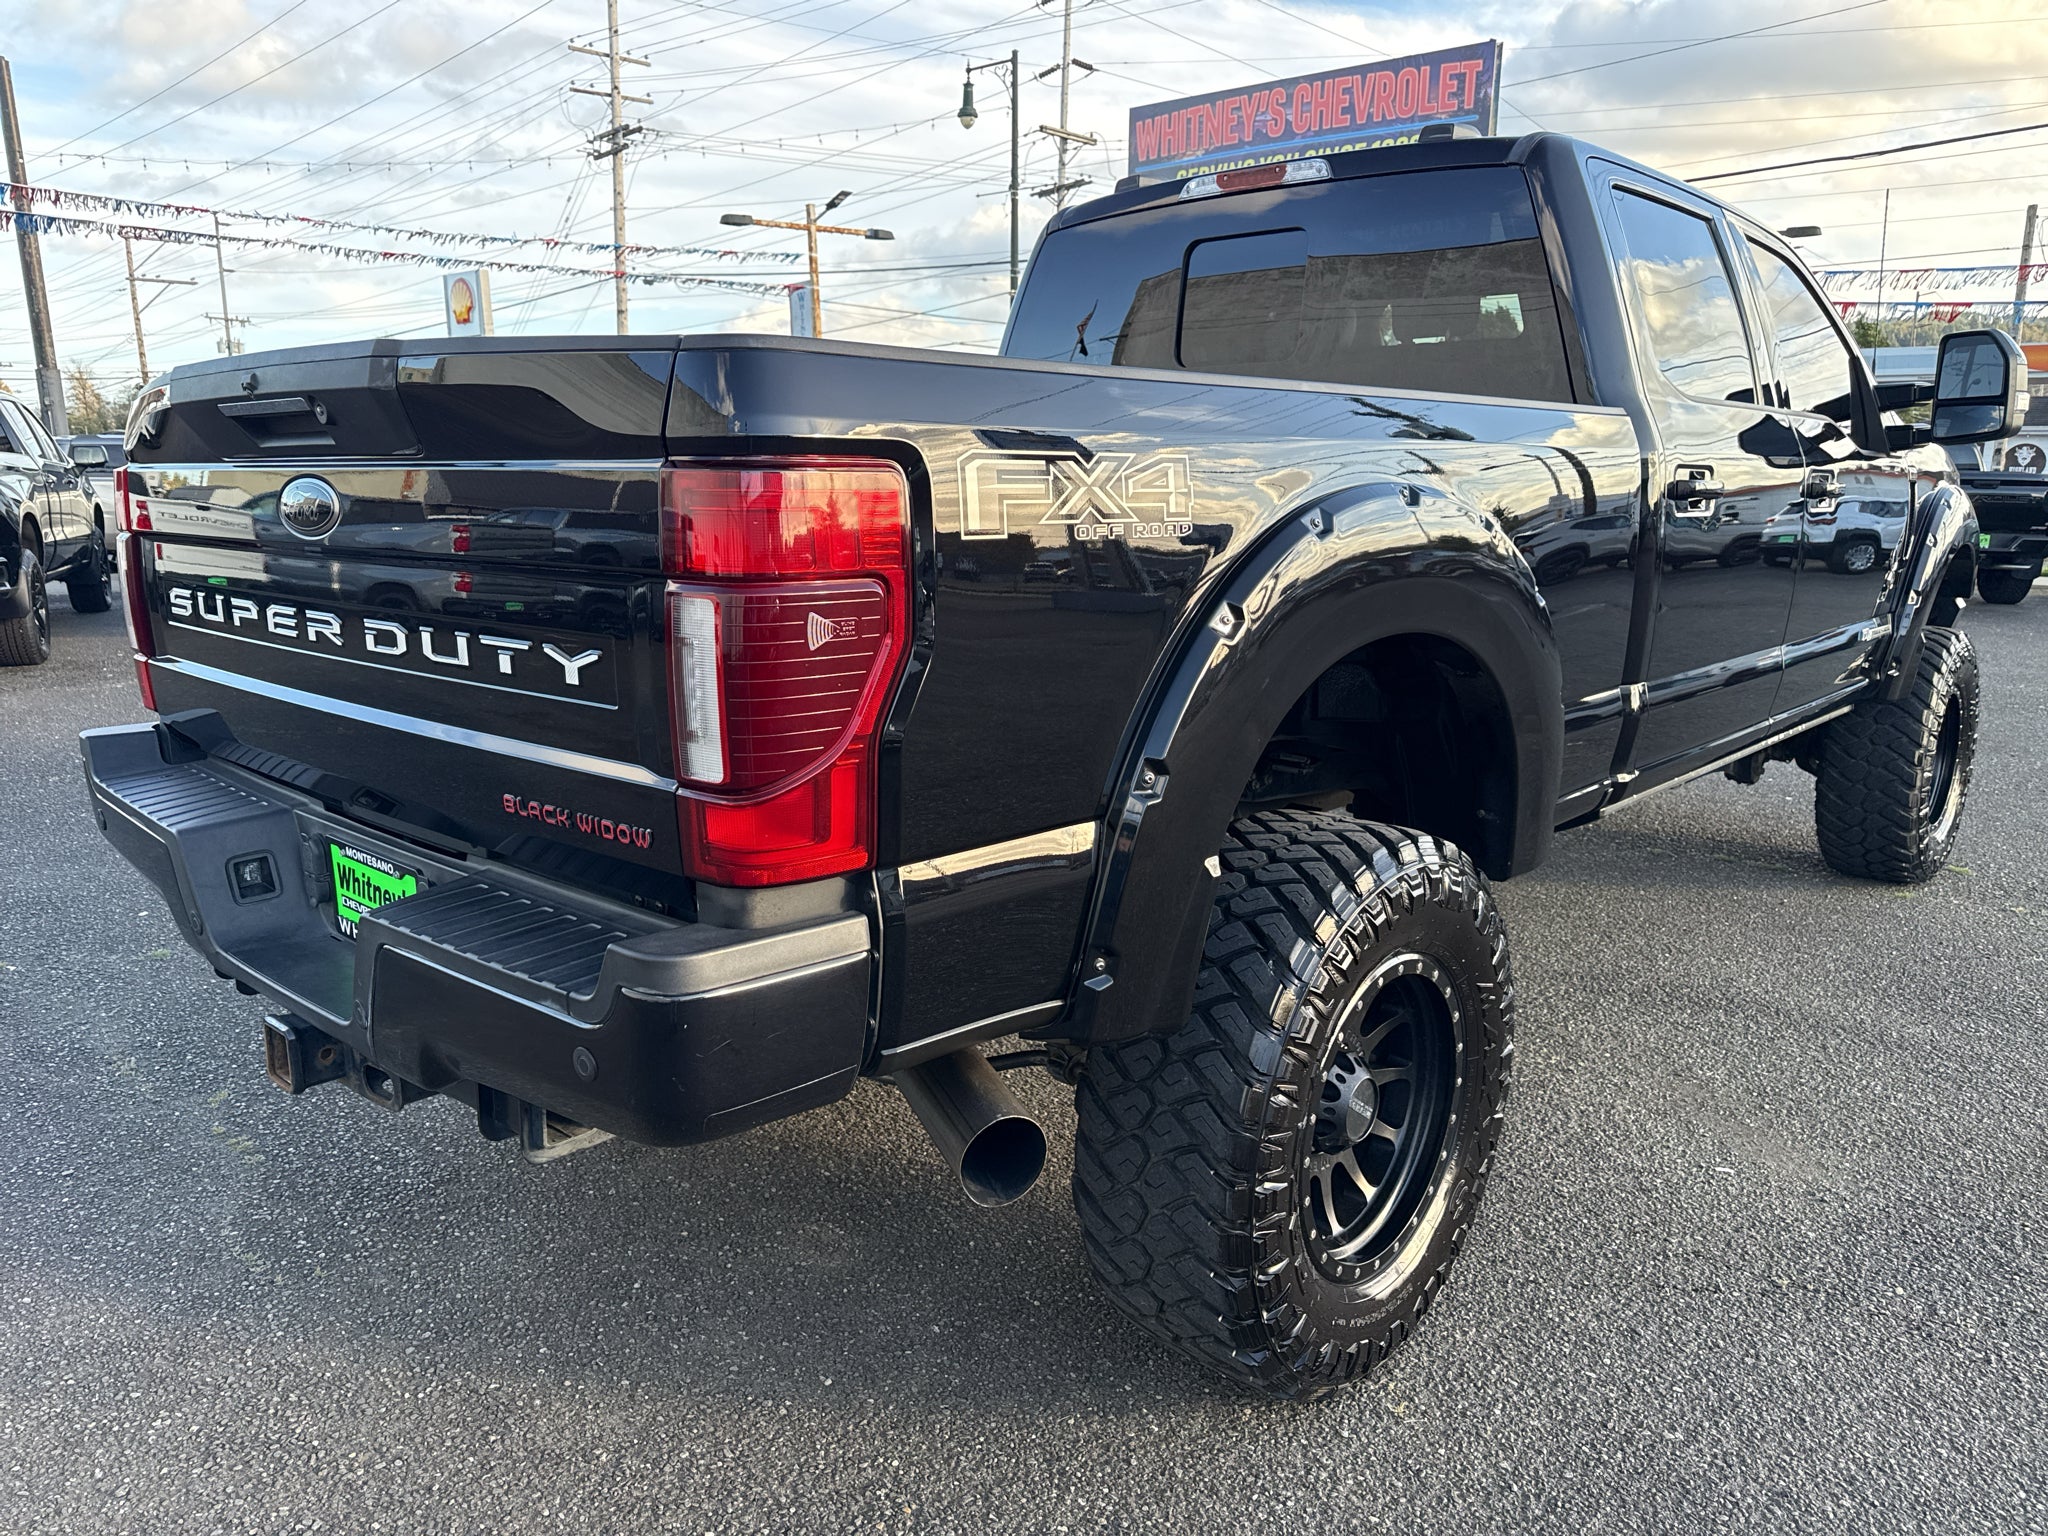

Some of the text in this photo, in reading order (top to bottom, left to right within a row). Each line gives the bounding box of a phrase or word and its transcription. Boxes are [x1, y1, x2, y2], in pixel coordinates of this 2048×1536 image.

[1135, 59, 1484, 163] WHITNEY'S CHEVROLET
[957, 449, 1194, 540] FX4
[1074, 522, 1193, 540] OFF ROAD
[168, 587, 602, 686] SUPER DUTY
[502, 793, 653, 849] BLACK WIDOW
[345, 846, 394, 875] MONTESANO
